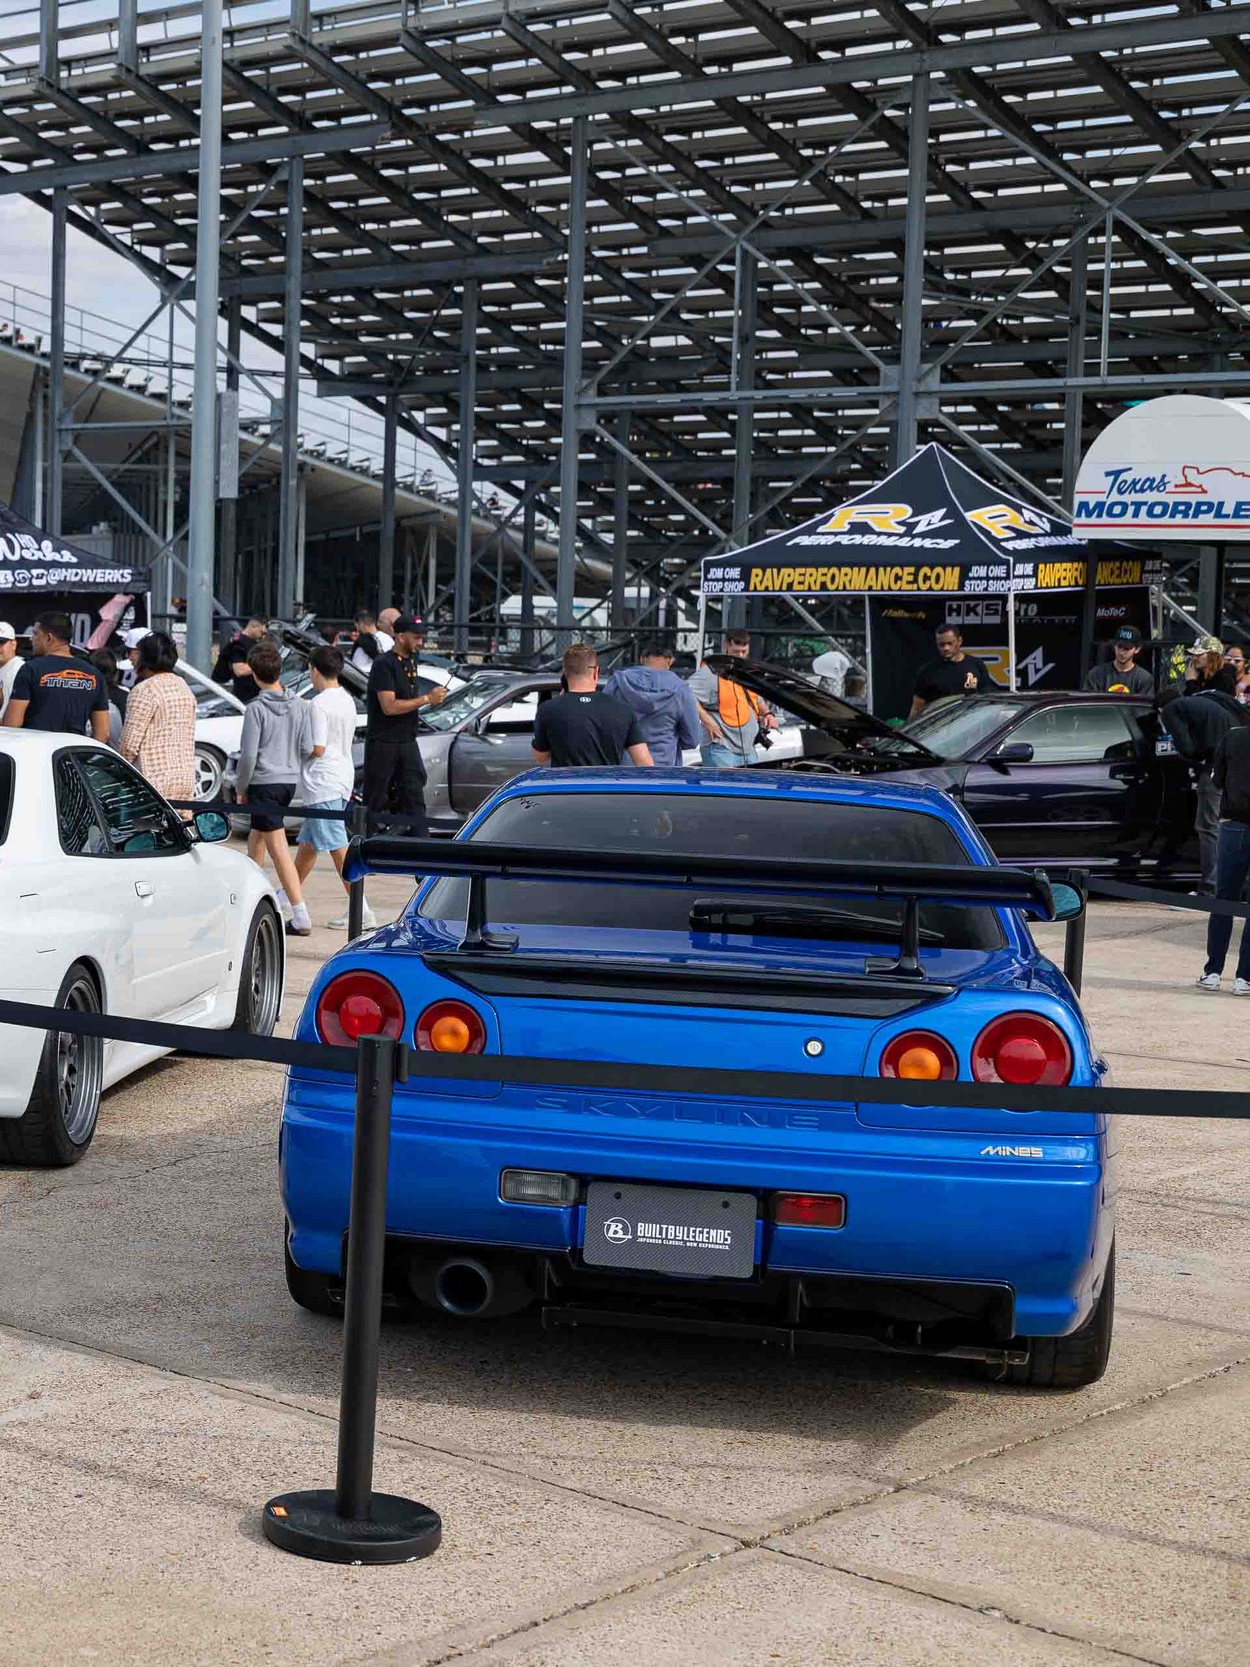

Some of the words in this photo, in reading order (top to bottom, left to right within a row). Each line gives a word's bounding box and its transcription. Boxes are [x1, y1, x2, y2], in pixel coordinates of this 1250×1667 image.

[1103, 467, 1171, 499] Texas
[786, 534, 961, 549] PERFORMANCE
[48, 568, 132, 584] @HDWERKS
[707, 567, 724, 579] JDM
[724, 567, 741, 579] ONE
[750, 566, 961, 592] RAVPERFORMANCE.COM
[969, 565, 987, 577] JDM
[988, 565, 1007, 578] ONE
[703, 581, 723, 592] STOP
[724, 581, 745, 592] SHOP
[964, 580, 987, 591] STOP
[988, 580, 1012, 591] SHOP
[946, 601, 1002, 621] HKS
[535, 1098, 819, 1131] SKYLINE
[637, 1223, 731, 1244] BUILTBYLEGENDS
